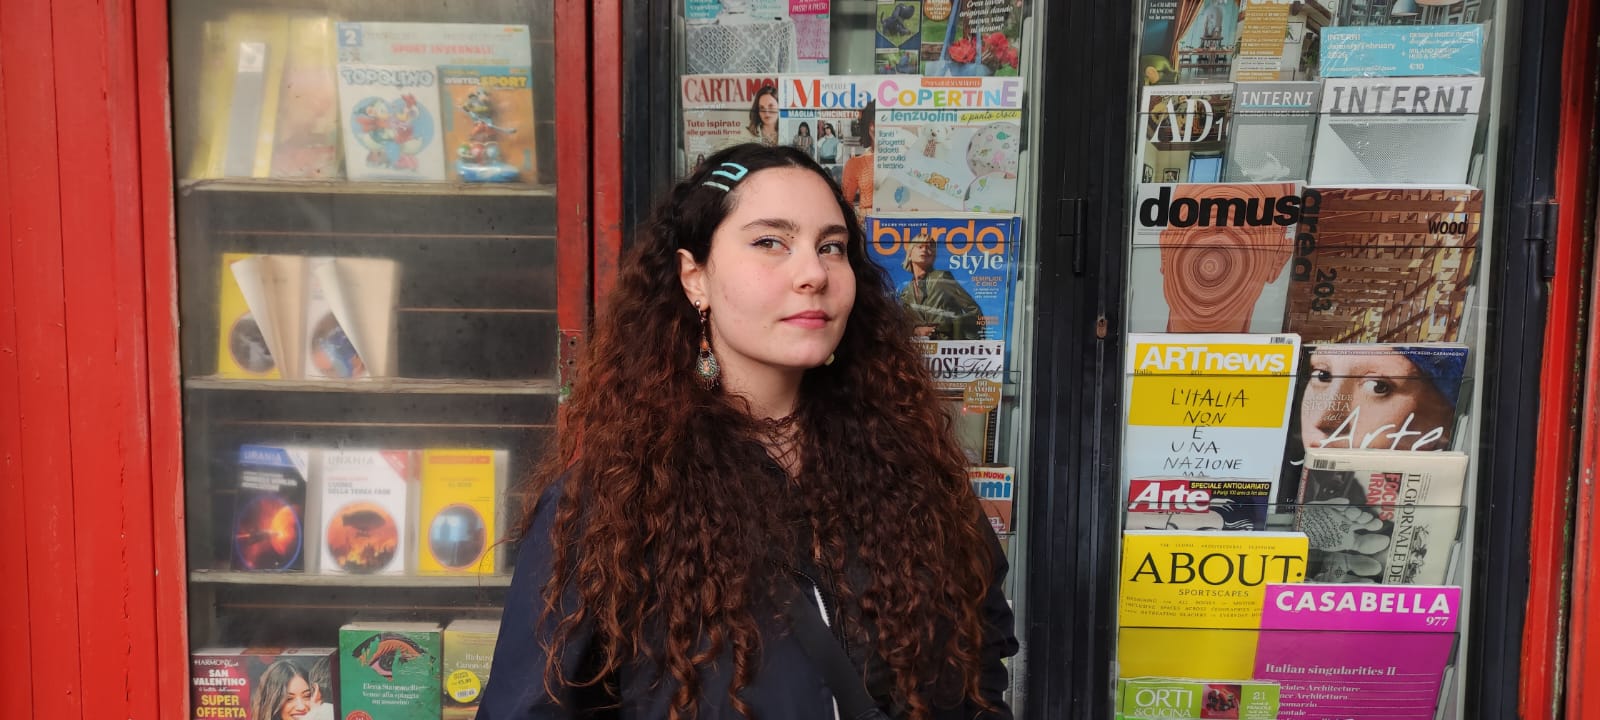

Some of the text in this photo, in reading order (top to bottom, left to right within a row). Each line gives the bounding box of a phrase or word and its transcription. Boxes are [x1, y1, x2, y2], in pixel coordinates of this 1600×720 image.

[341, 69, 434, 88] TOPOLINO
[481, 76, 528, 88] SPORT
[790, 79, 872, 108] Moda
[877, 80, 1019, 107] COPERTINE
[1240, 91, 1314, 106] INTERNI
[1330, 86, 1473, 117] INTERNI
[890, 110, 958, 122] lenzuolini
[1150, 99, 1213, 142] AD
[878, 138, 905, 147] progetti
[1139, 186, 1302, 228] domus
[1428, 214, 1468, 235] wood
[872, 220, 1005, 256] burda
[1293, 189, 1322, 282] area
[949, 251, 1003, 275] style
[1312, 268, 1337, 312] 203
[941, 345, 1002, 356] motivi
[1140, 346, 1286, 372] ARTnews
[1171, 389, 1249, 408] L'ITALIA
[1303, 401, 1351, 412] STORIA
[1183, 410, 1227, 424] NON
[1318, 405, 1444, 451] Arte
[1171, 441, 1220, 454] UNA
[1163, 456, 1243, 470] NAZIONE
[1190, 482, 1270, 490] SPECIALE ANTIQUARIATO
[1366, 473, 1385, 505] IRAN
[1128, 482, 1211, 511] Arte
[1379, 473, 1401, 521] FOCUS
[1393, 487, 1420, 563] GIORNALE
[1178, 588, 1249, 598] SPORTSCAPES
[1276, 590, 1450, 614] CASABELLA
[1426, 616, 1449, 626] 977
[208, 669, 229, 678] SAN
[1266, 663, 1396, 677] Italian singularities II
[193, 677, 246, 686] VALENTINO
[363, 682, 381, 690] Elena
[1308, 684, 1361, 692] Architecture
[201, 694, 240, 706] SUPER
[1136, 687, 1193, 708] ORTI
[1296, 692, 1348, 700] Architettura
[196, 706, 247, 718] OFFERTA
